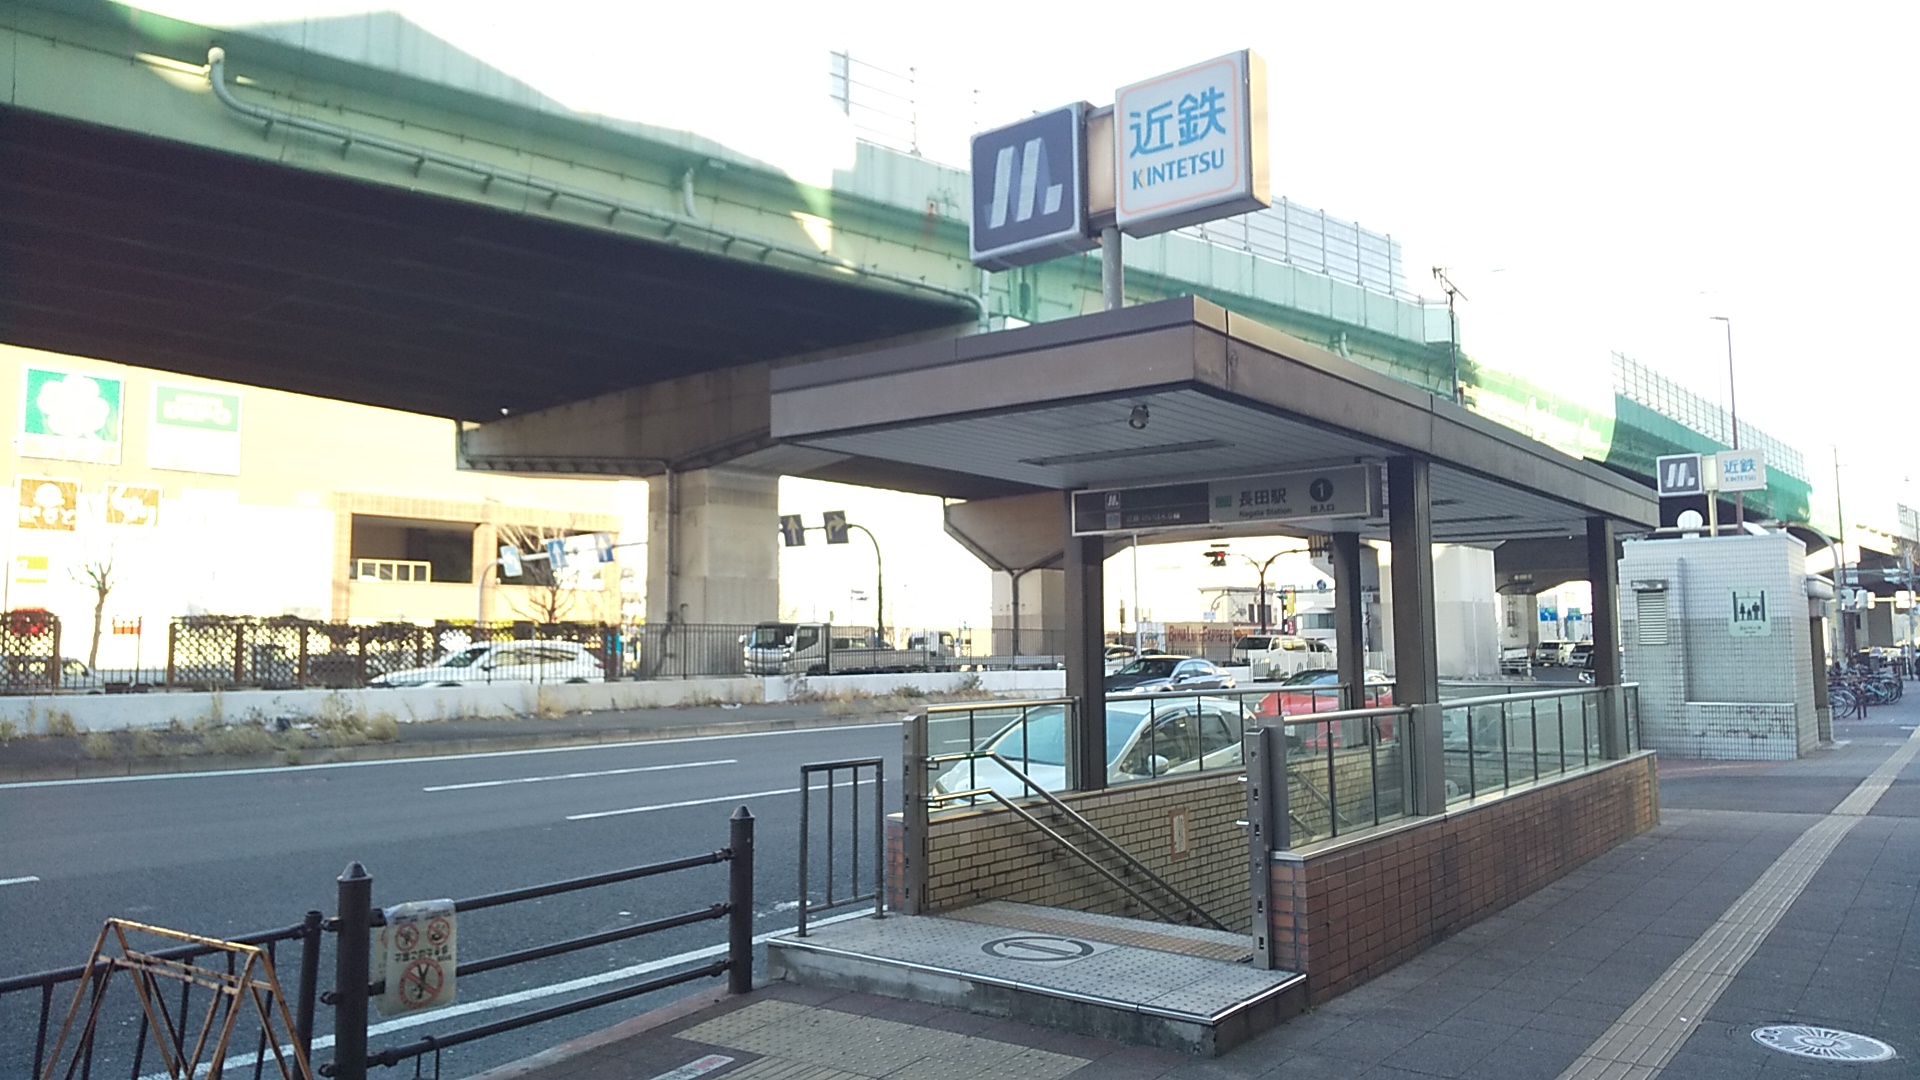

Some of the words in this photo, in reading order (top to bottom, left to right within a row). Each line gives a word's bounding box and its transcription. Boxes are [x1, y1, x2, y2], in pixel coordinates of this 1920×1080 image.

[1130, 86, 1226, 158] 近鉄
[1132, 148, 1225, 191] KINTETSU
[1723, 458, 1756, 474] 近鉄
[1239, 487, 1286, 507] 長田駅
[1239, 509, 1263, 519] Nagata
[1266, 507, 1292, 516] Station
[1310, 504, 1335, 513] 出入口
